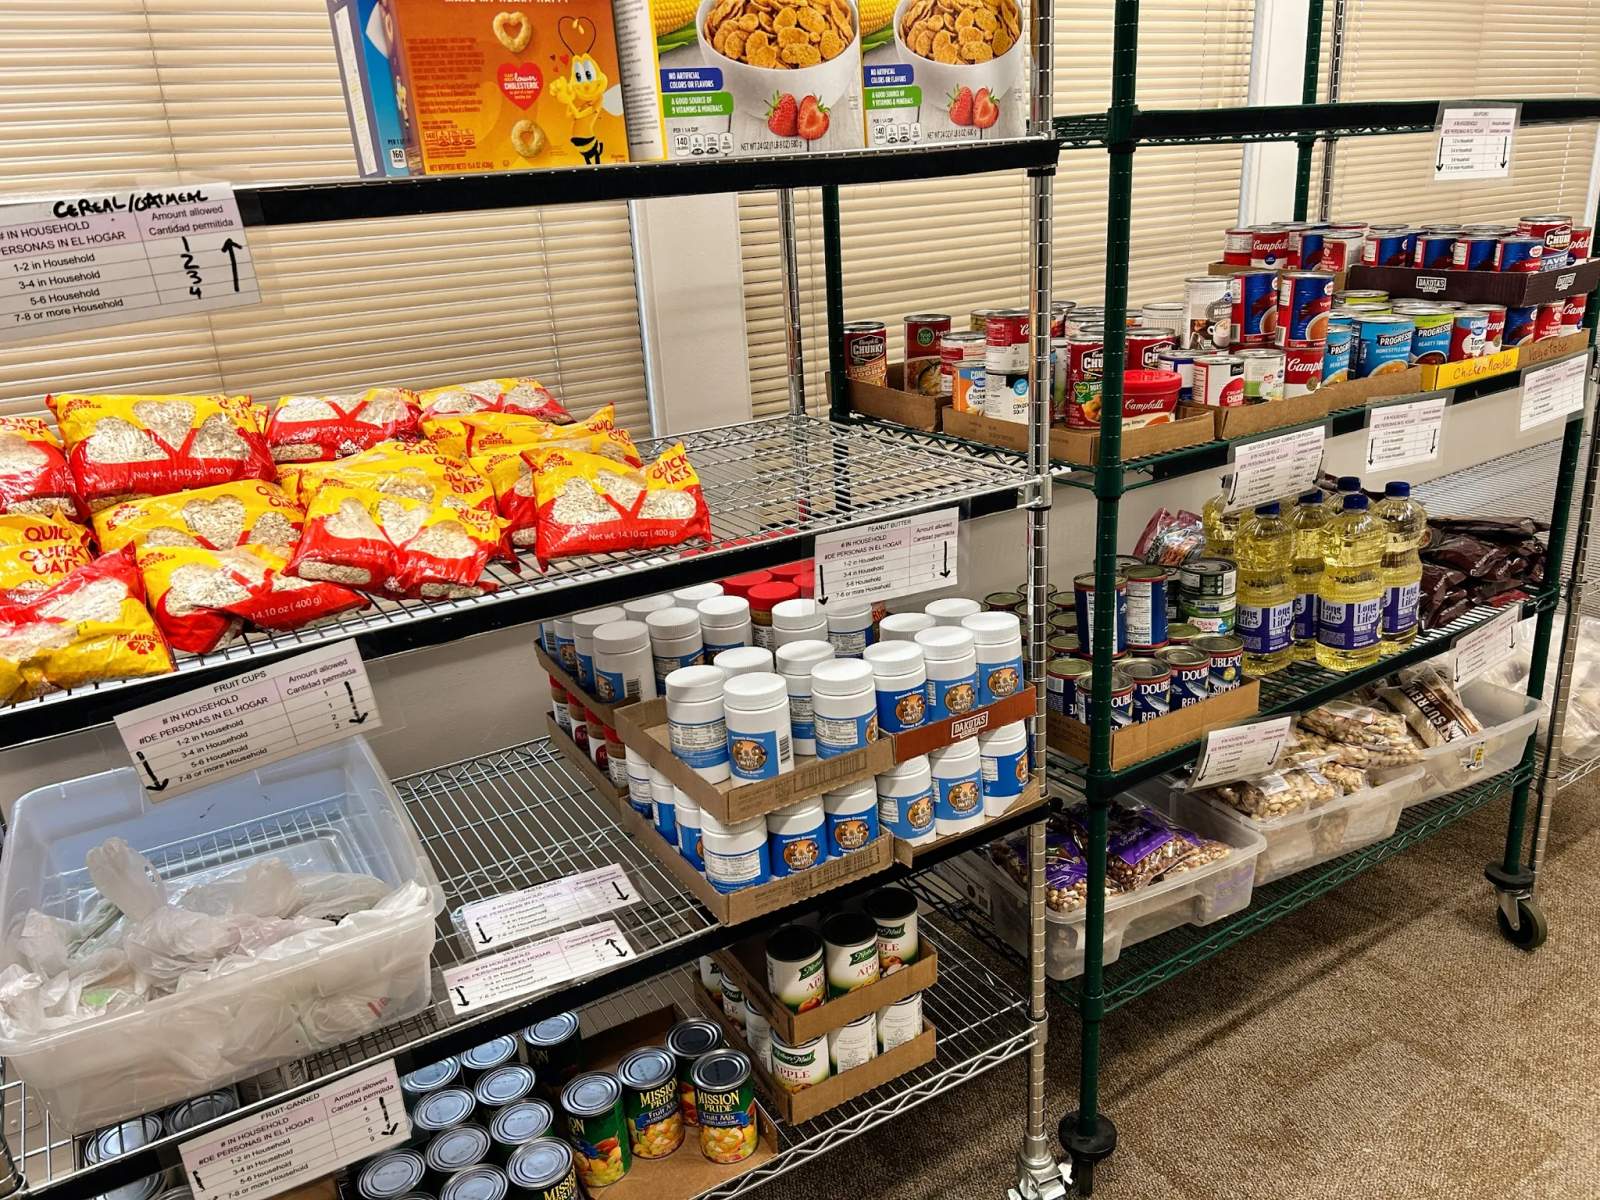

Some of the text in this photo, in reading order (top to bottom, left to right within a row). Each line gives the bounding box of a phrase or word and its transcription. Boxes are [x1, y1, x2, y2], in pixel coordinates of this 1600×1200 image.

[695, 80, 714, 88] FLAVORS
[152, 205, 224, 222] Amount allowed
[7, 221, 90, 239] IN HOUSEHOLD
[149, 218, 234, 236] Cantidad permitida
[1, 231, 126, 256] ERSONAS IN EL HOGAR
[182, 236, 190, 252] 1
[14, 254, 95, 272] 1-2 in Household
[180, 254, 200, 270] 2
[19, 271, 101, 290] 3-4 in Household
[186, 270, 202, 285] 3
[30, 288, 100, 306] 5-6 Household
[189, 286, 201, 300] 4
[14, 299, 124, 322] 7-8 or more Household
[1380, 331, 1412, 346] PROGRESS
[1418, 324, 1451, 337] PROGRESS
[853, 344, 883, 355] CHUNKY
[868, 519, 912, 532] PEANUT BUTTER
[589, 532, 603, 541] Net
[853, 534, 887, 546] HOUSEHOLD
[836, 547, 867, 558] PERSONAS
[883, 540, 902, 550] HOGAR
[858, 554, 885, 564] Household
[858, 565, 884, 575] Household
[856, 576, 882, 586] Household
[866, 583, 891, 593] Household
[288, 659, 348, 684] Amount allowed
[214, 670, 267, 693] FRUIT CUPS
[286, 667, 357, 696] Cantidad permitida
[1142, 681, 1171, 694] DOUBL
[170, 713, 180, 723] IN
[182, 694, 239, 719] HOUSEHOLD
[139, 696, 269, 745] #DE PERSONAS IN EL HOGAR
[954, 714, 986, 733] DAKOTAS
[176, 720, 244, 746] 1-2 in Household
[181, 749, 195, 758] 3-4
[206, 731, 249, 751] Household
[179, 774, 192, 782] 7-8
[204, 764, 225, 774] more
[226, 748, 268, 766] Household
[191, 744, 249, 768] 5-6 Household
[331, 1084, 394, 1113] Cantidad permitida
[334, 1077, 388, 1103] Amount allowed
[698, 1089, 740, 1106] MISSION
[261, 1093, 320, 1120] FRUIT-CANNED
[704, 1103, 733, 1113] PRIDE
[228, 1136, 236, 1145] IN
[238, 1117, 289, 1142] HOUSEHOLD
[199, 1155, 214, 1165] #DE
[217, 1137, 262, 1159] PERSONAS
[285, 1116, 314, 1132] HOGAR
[252, 1138, 291, 1156] Household
[233, 1167, 245, 1175] 3-4
[255, 1149, 294, 1167] Household
[253, 1161, 292, 1179] Household
[250, 1180, 269, 1190] more
[271, 1164, 309, 1182] Household
